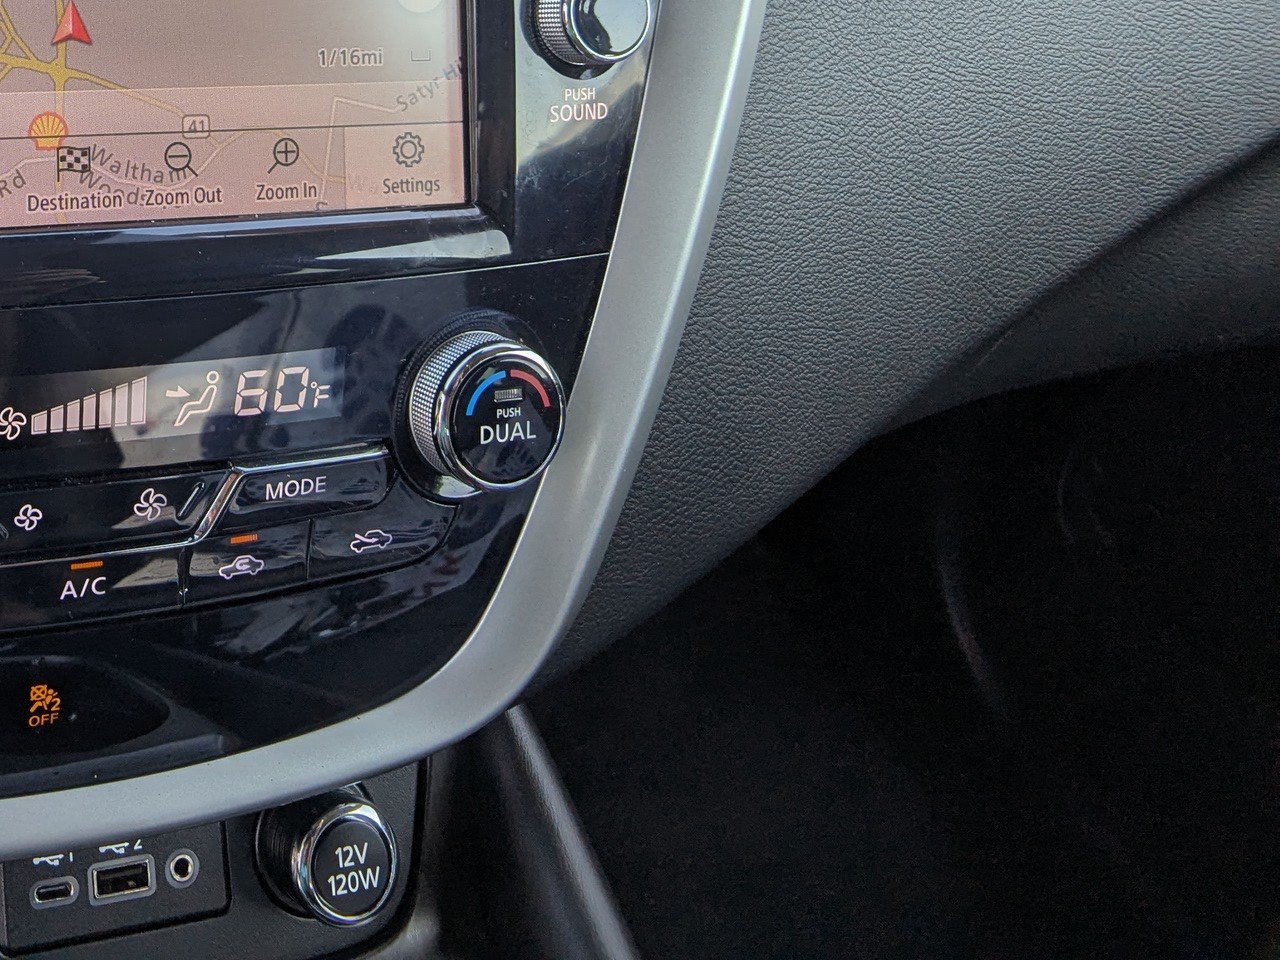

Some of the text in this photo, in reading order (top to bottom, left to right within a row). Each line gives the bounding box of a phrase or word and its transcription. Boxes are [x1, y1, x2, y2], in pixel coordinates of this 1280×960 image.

[564, 87, 596, 101] PUSH
[550, 102, 609, 123] SOUND
[145, 187, 223, 206] Zoom Out
[256, 182, 318, 201] Zoom In
[382, 177, 441, 196] Settings
[27, 192, 123, 212] Destination
[495, 406, 522, 418] PUSH
[479, 420, 538, 445] DUAL
[265, 475, 327, 501] MODE
[59, 576, 107, 601] A/C
[28, 712, 60, 728] OFF
[334, 842, 369, 869] 12V
[327, 866, 381, 897] 120W
